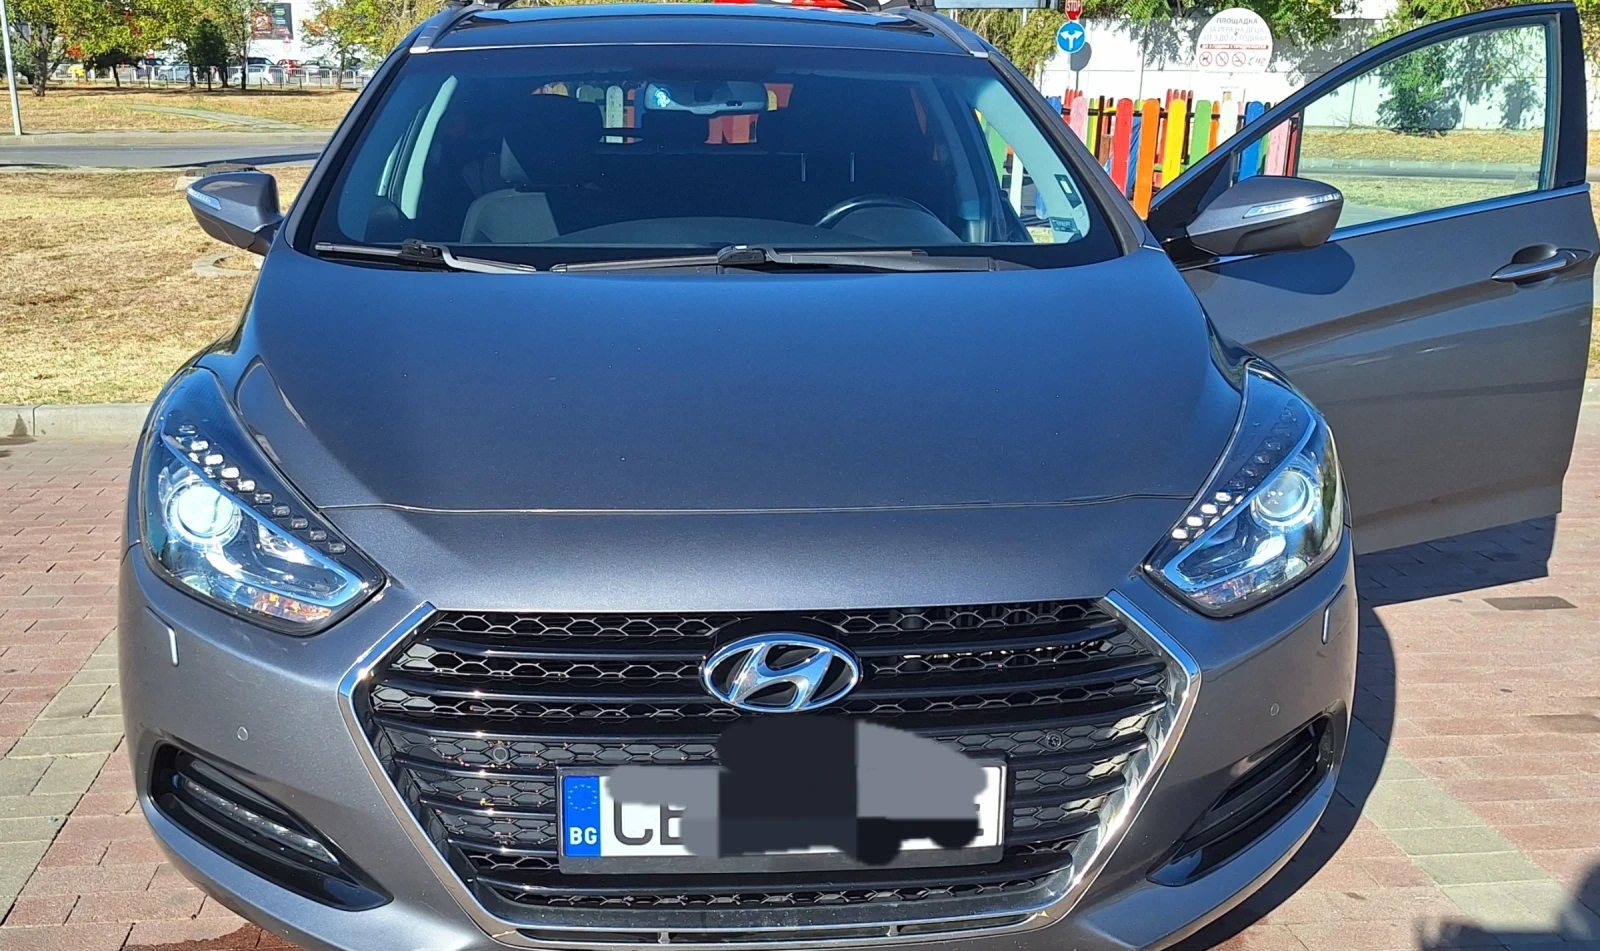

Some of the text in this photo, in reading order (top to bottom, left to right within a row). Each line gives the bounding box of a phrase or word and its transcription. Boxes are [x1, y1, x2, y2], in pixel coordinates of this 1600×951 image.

[1067, 1, 1080, 12] STOP
[1216, 17, 1258, 25] ПЛОЩАДКА
[1245, 26, 1264, 34] ДЕЦА
[1218, 34, 1228, 42] ДО
[569, 826, 598, 845] BG
